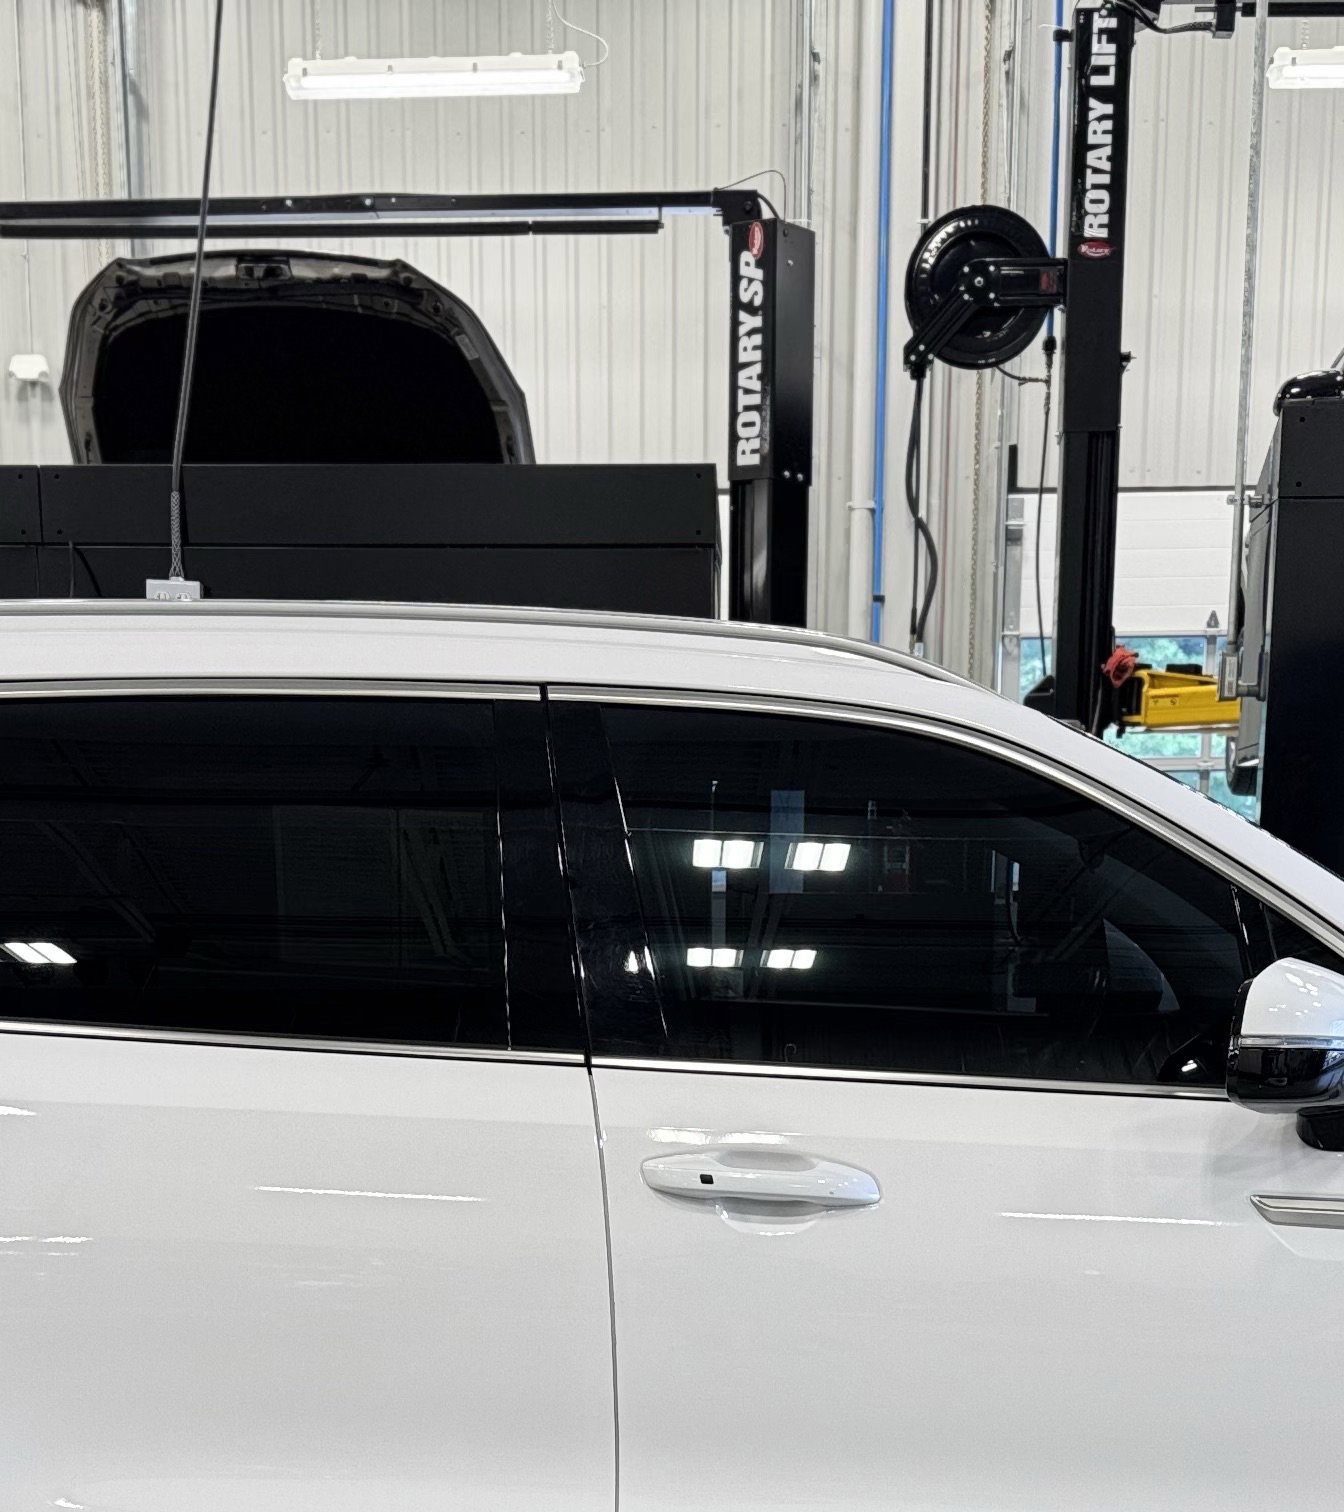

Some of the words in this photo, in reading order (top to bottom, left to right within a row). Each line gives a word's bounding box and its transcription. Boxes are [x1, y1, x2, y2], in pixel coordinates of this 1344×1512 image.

[1089, 11, 1118, 86] LIFT
[1084, 96, 1114, 238] ROTARY
[738, 250, 764, 307] SP
[736, 310, 763, 467] ROTARY
